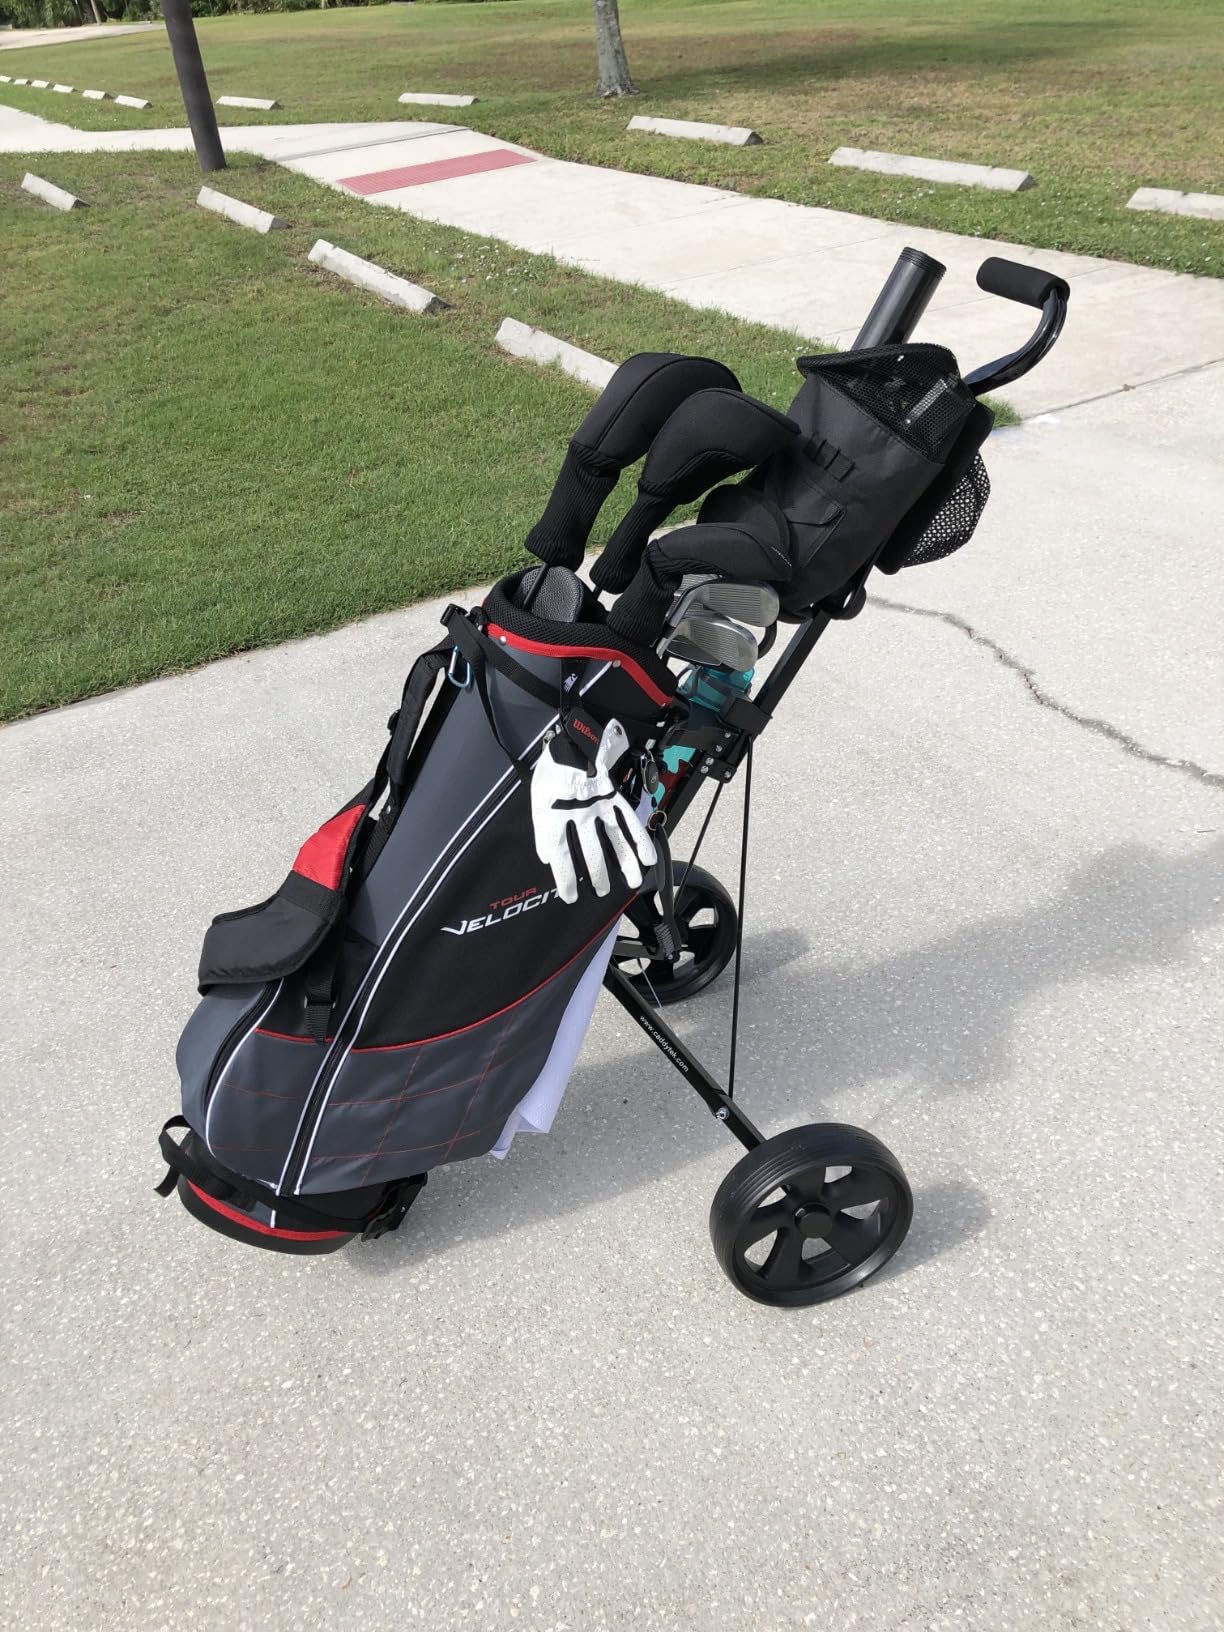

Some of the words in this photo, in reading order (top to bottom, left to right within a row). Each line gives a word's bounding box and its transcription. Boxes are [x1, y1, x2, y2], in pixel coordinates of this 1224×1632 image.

[572, 719, 599, 744] Wilson
[440, 877, 583, 935] VELOCIT
[489, 887, 537, 910] TOUR
[640, 1016, 689, 1072] www.caddytek.com
